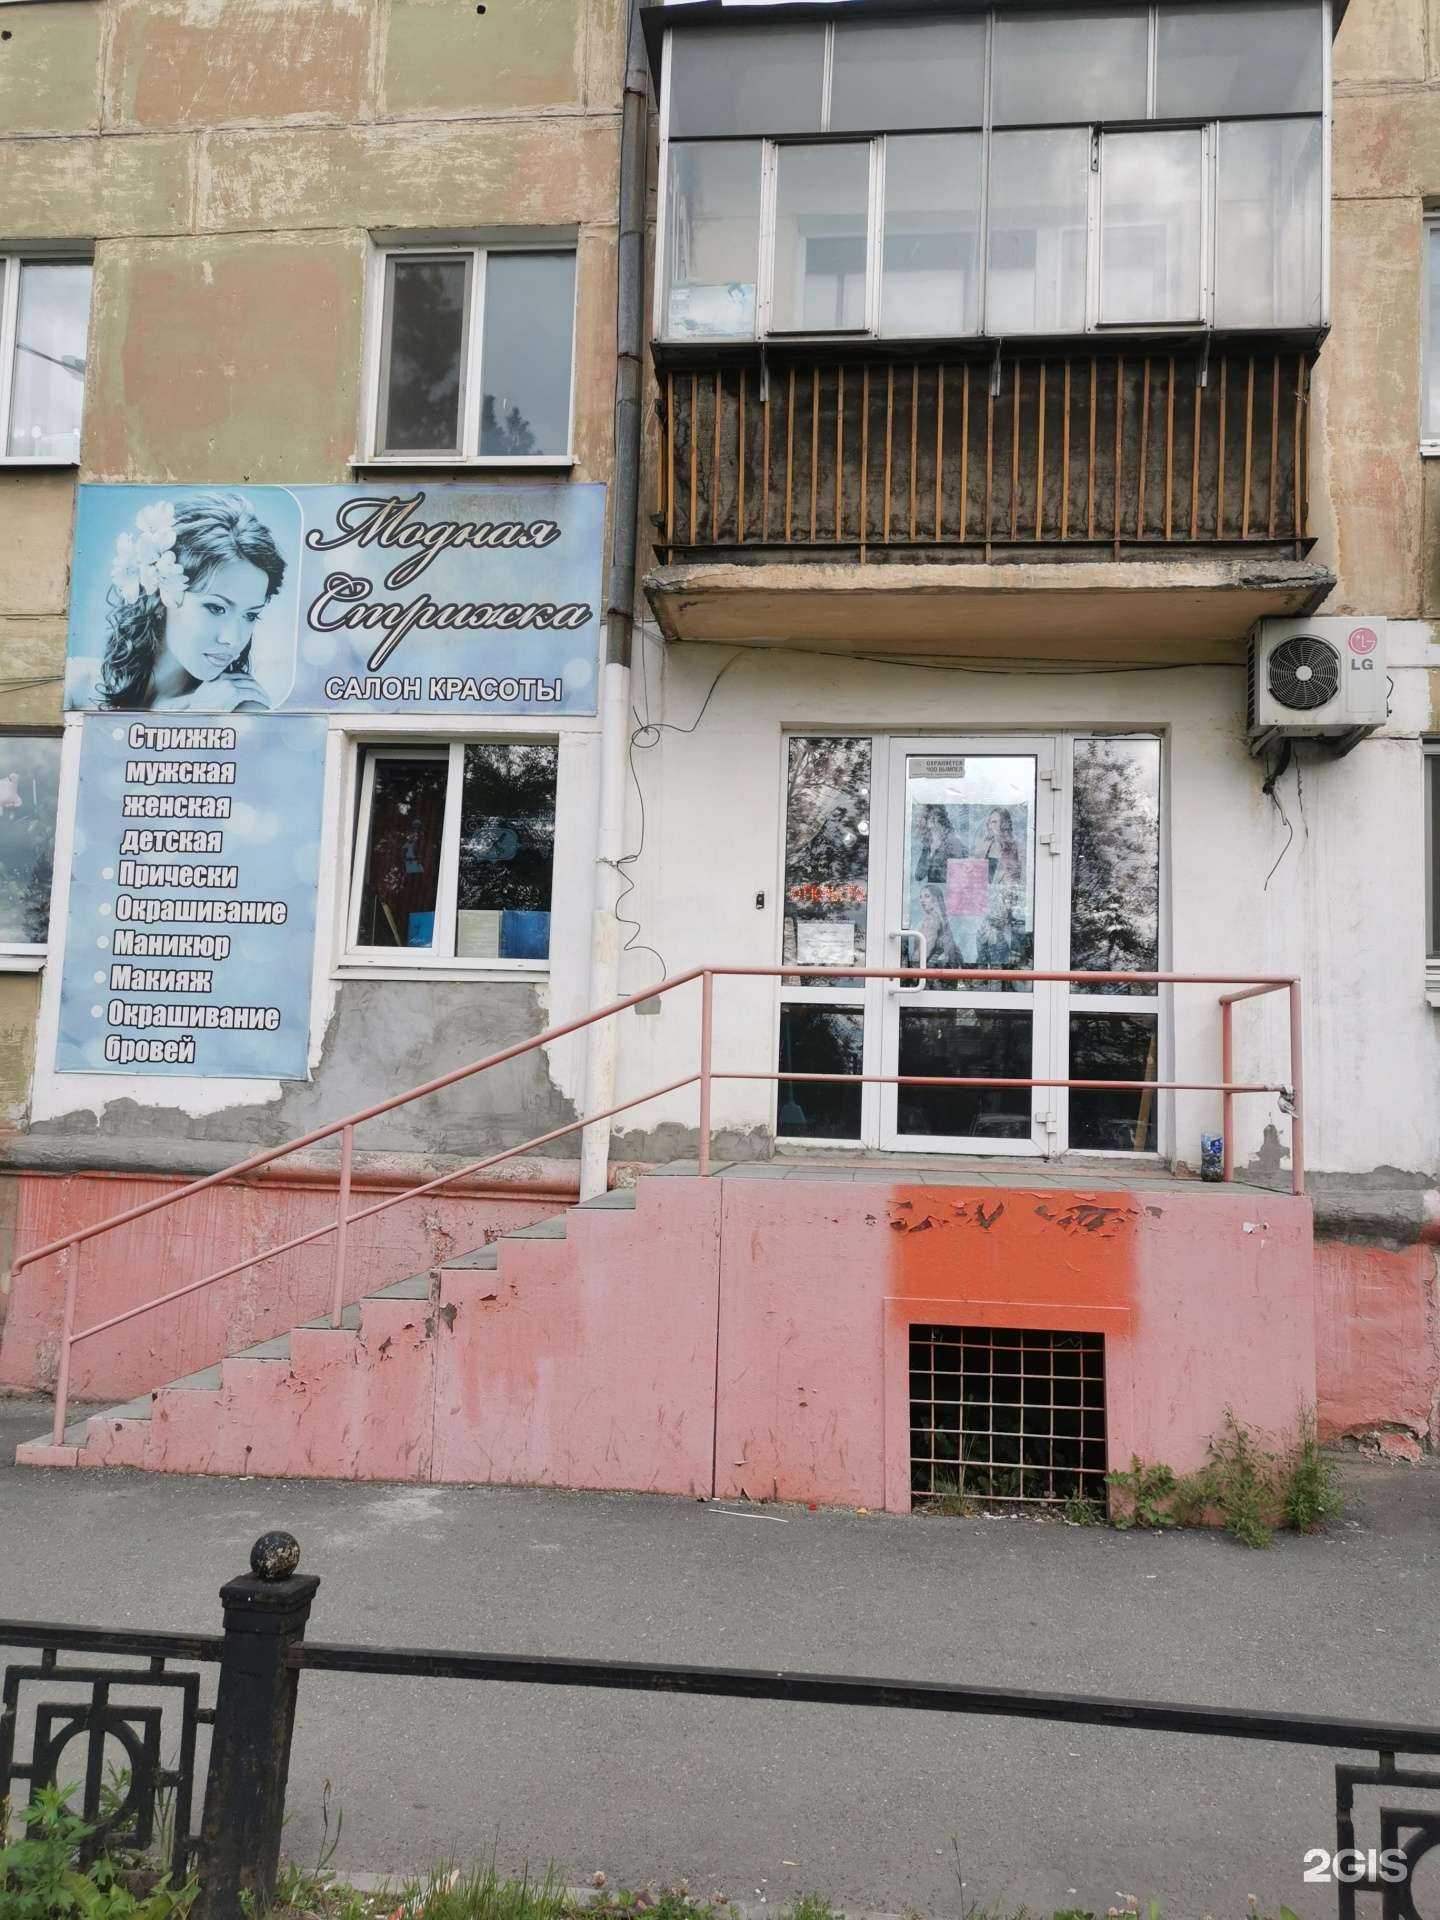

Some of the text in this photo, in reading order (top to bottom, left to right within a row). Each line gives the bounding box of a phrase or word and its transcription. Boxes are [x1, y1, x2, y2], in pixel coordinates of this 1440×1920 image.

[305, 491, 561, 590] Модная
[307, 572, 593, 672] Стрижка
[1351, 658, 1374, 671] LG
[325, 677, 562, 701] САЛОН КРАСОТЫ
[128, 722, 236, 751] Стрижка
[125, 761, 236, 785] мужская
[122, 795, 231, 818] женская
[120, 829, 223, 854] детская
[118, 860, 238, 888] Прически
[116, 894, 287, 925] Окрашивание
[113, 929, 231, 960] Маникюр
[110, 964, 213, 993] Макияж
[108, 999, 280, 1030] Окрашивание
[105, 1034, 195, 1064] бровей
